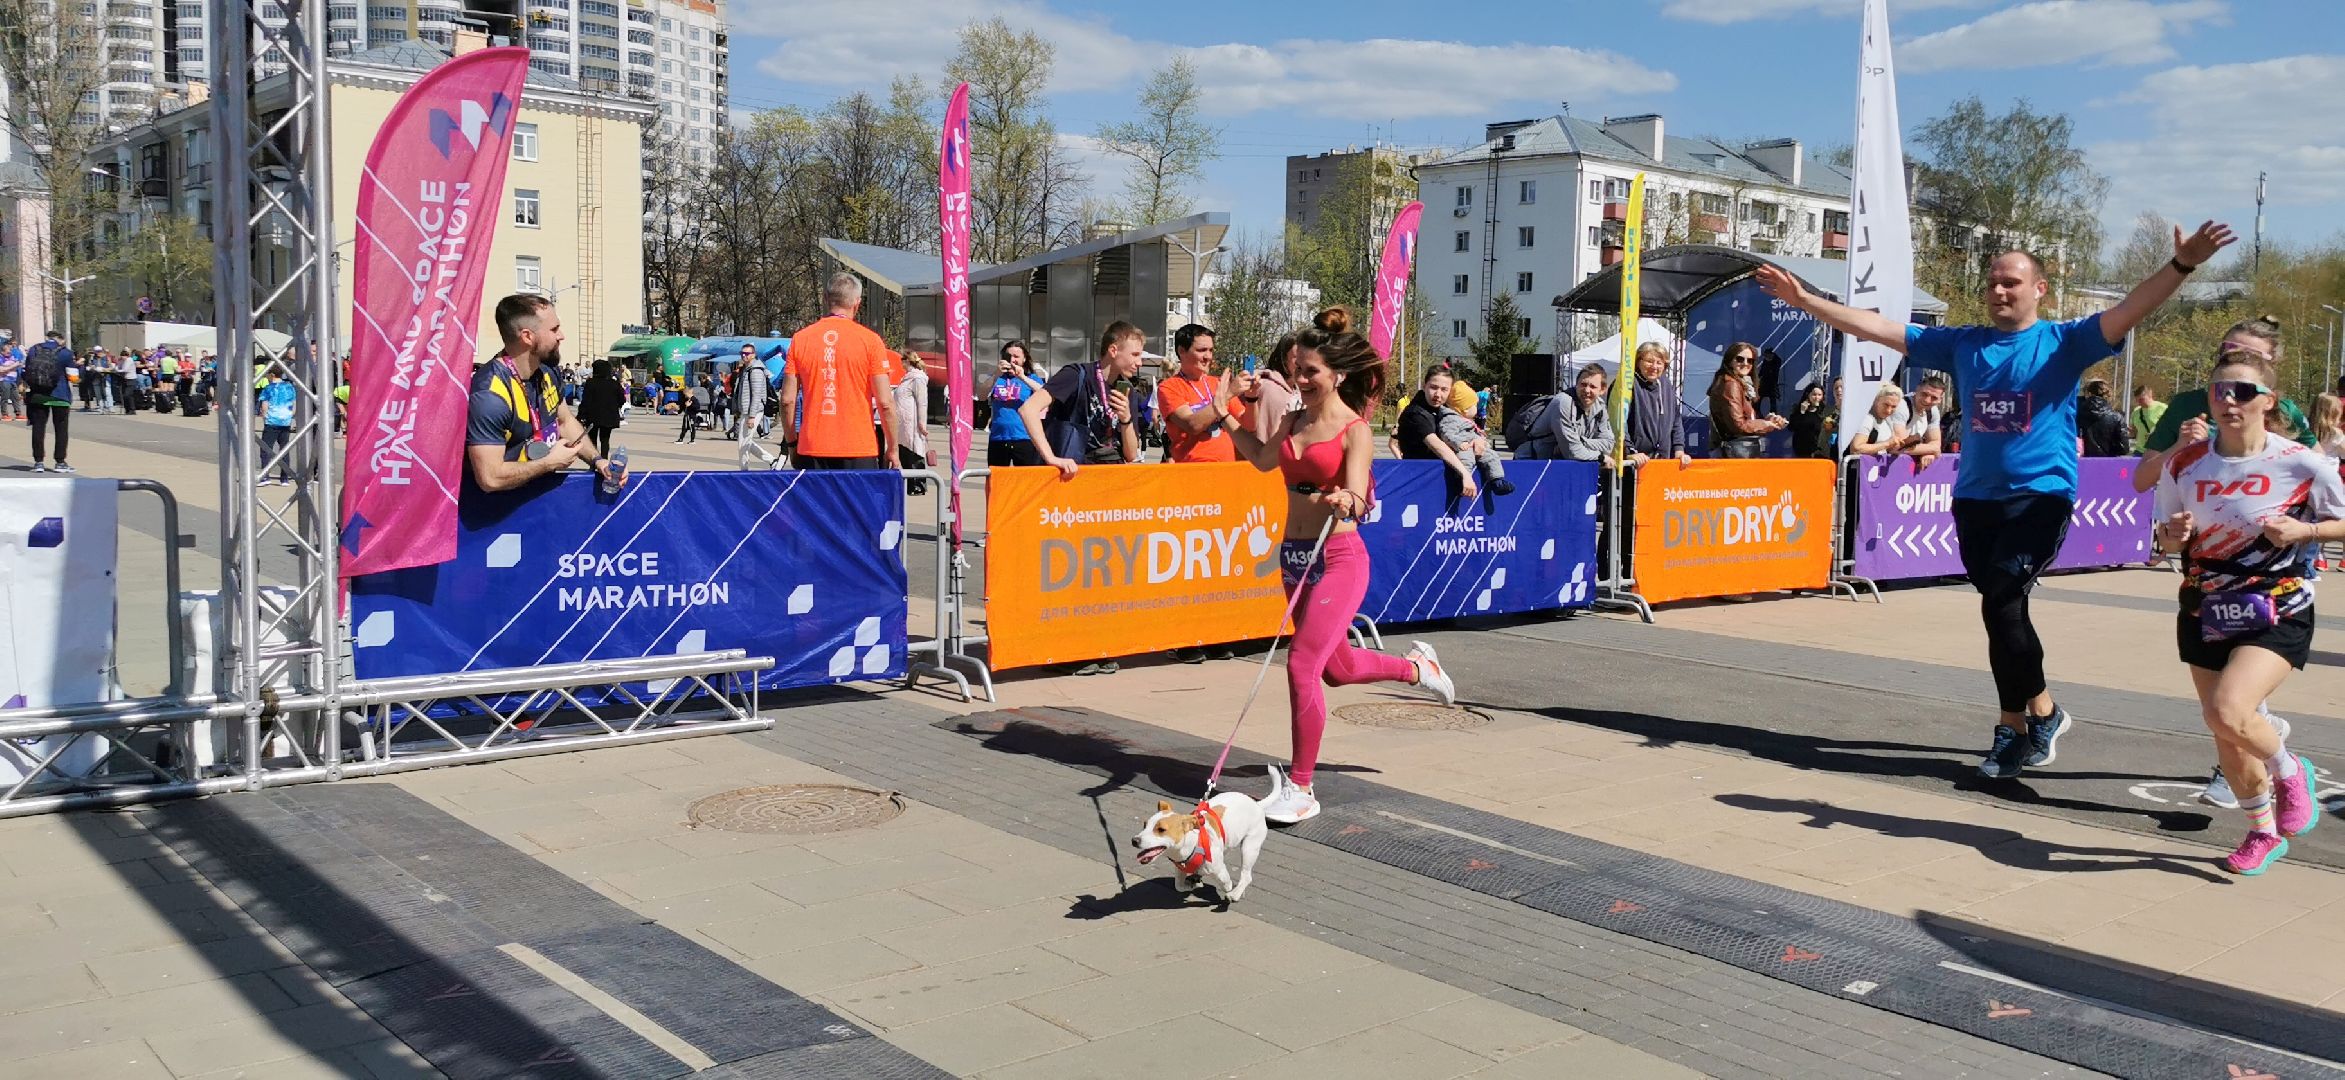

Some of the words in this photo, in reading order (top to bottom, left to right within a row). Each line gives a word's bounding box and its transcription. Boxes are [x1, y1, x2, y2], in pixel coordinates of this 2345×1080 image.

[1980, 400, 2016, 415] 1431
[1663, 487, 1729, 503] Эффективные
[1730, 486, 1768, 500] средства
[1039, 506, 1154, 528] Эффективные
[1156, 503, 1222, 523] средства
[1435, 515, 1484, 533] SPACE
[558, 552, 659, 578] SPACE
[2211, 602, 2256, 620] 1184
